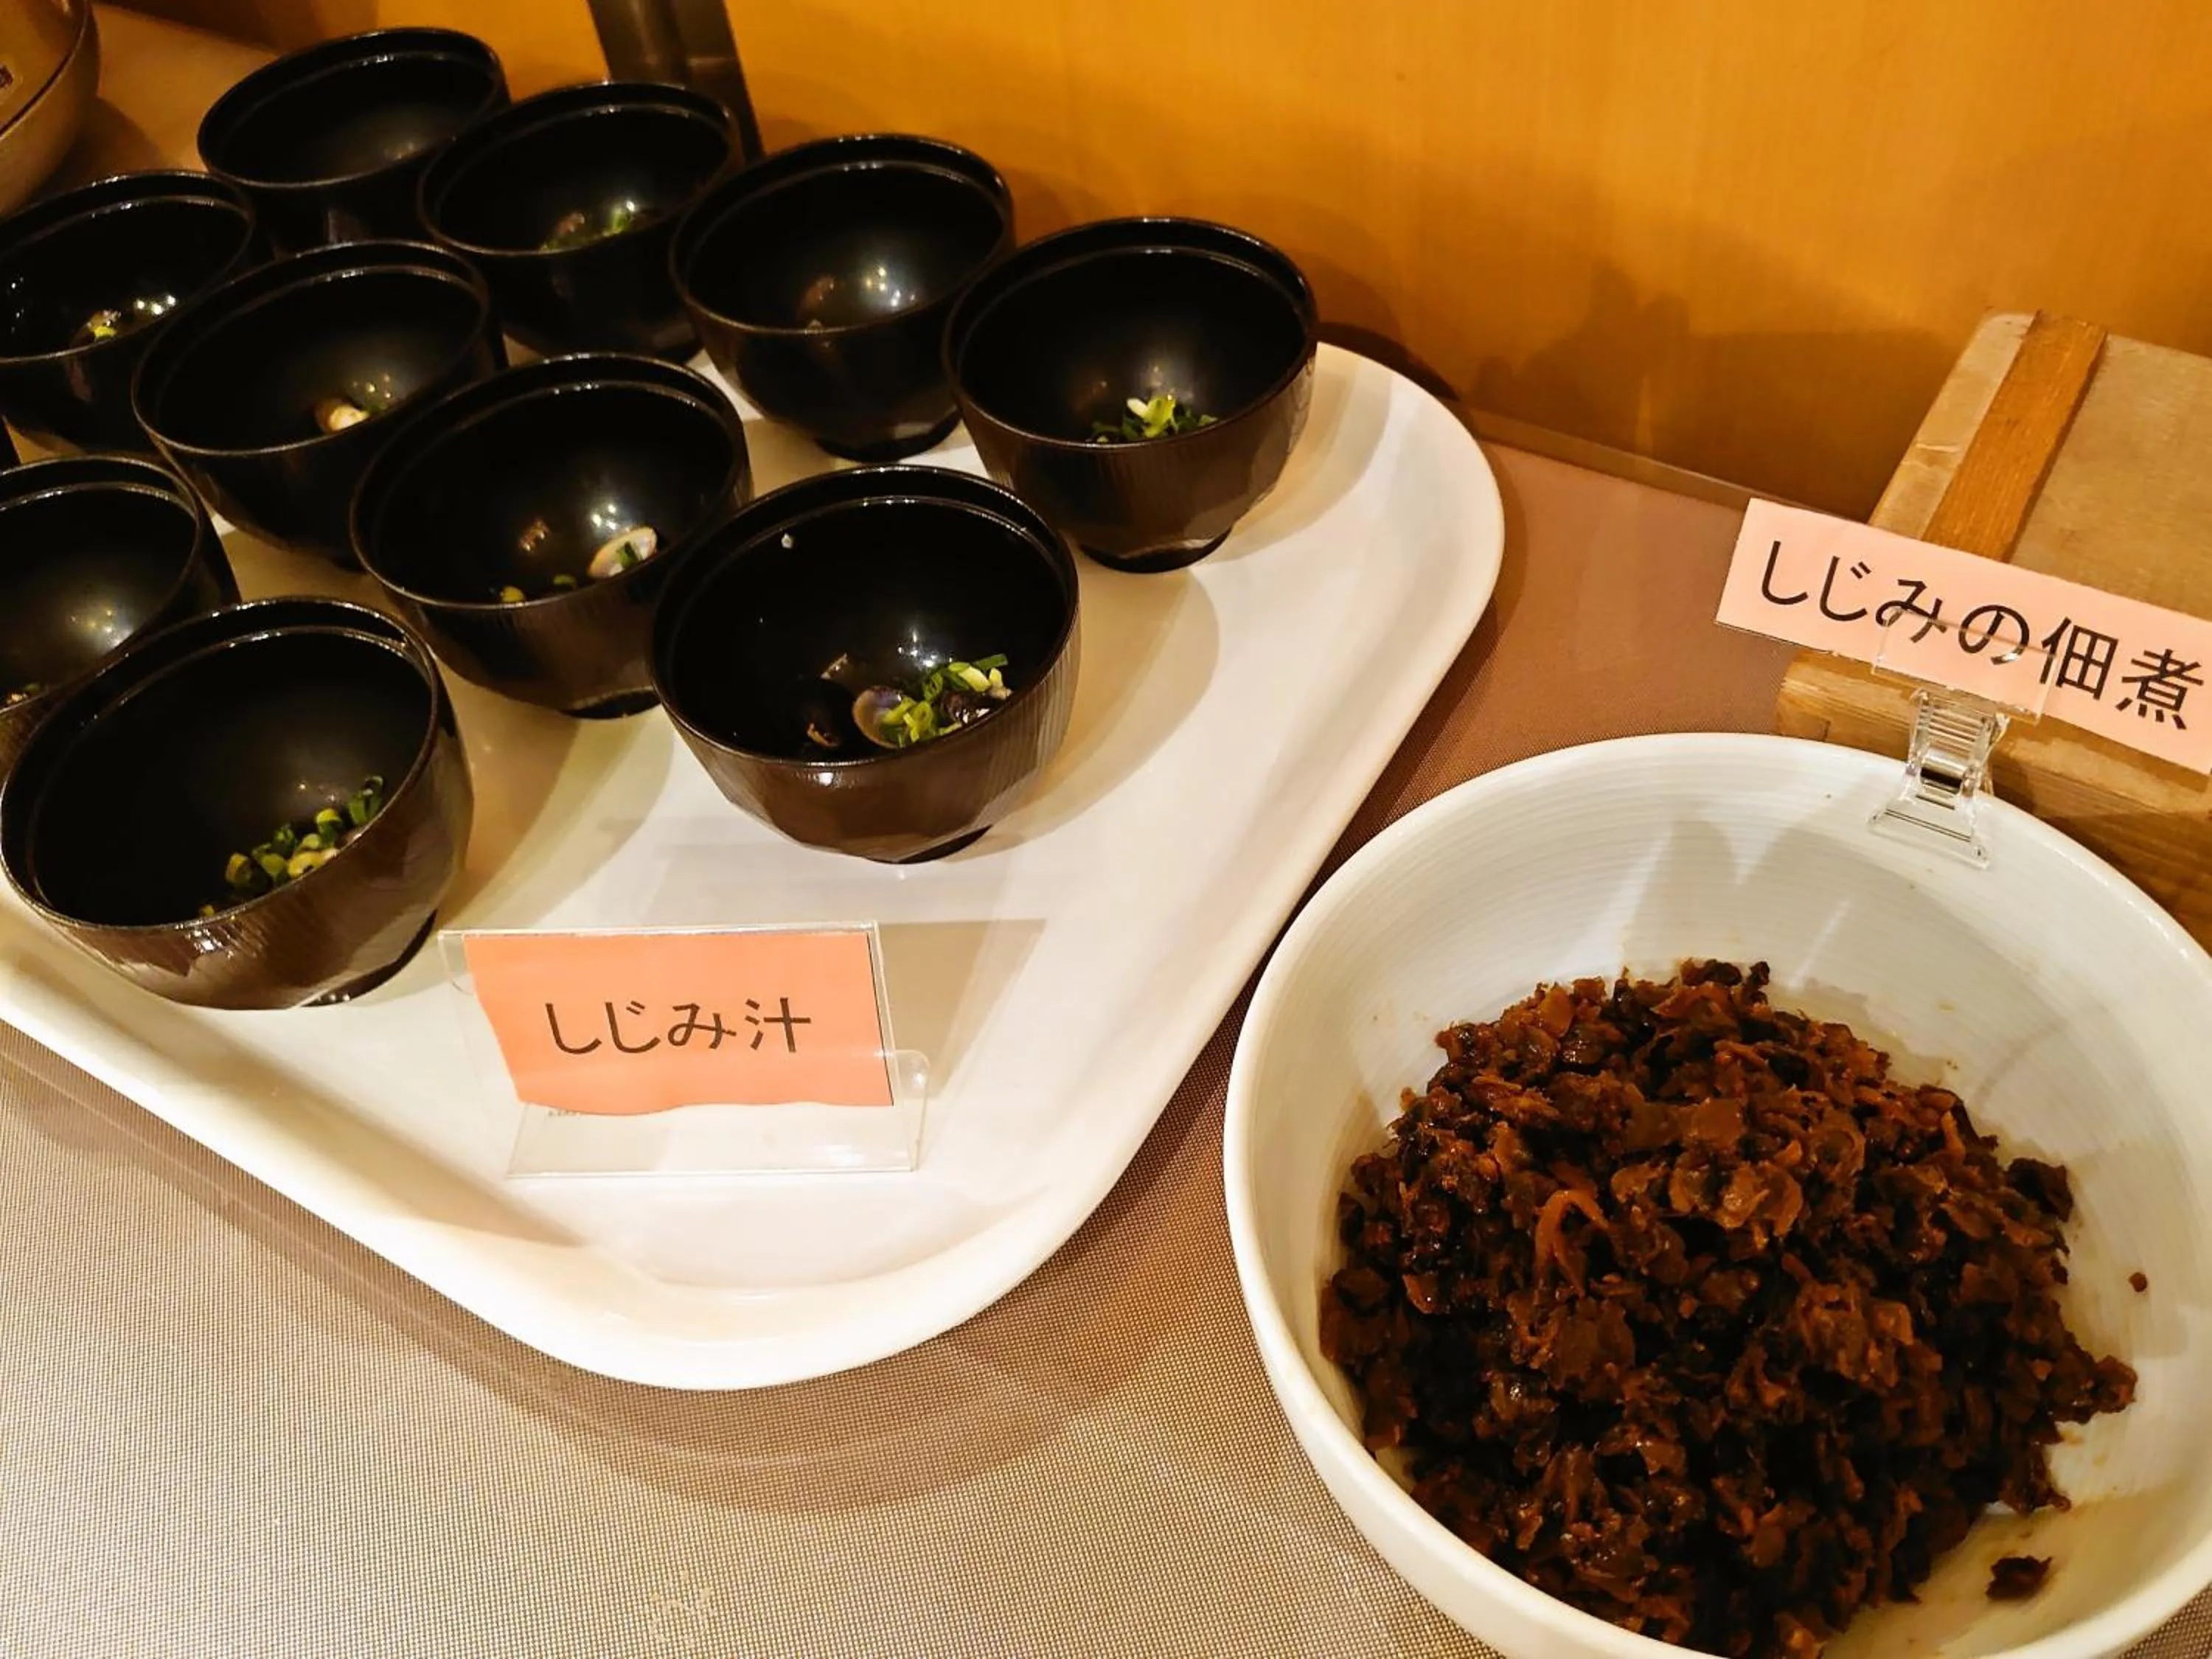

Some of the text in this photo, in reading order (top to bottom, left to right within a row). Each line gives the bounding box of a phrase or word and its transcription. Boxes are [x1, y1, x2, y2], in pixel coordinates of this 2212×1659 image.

[1761, 540, 2205, 731] しじみの佃煮
[545, 997, 811, 1054] しじみ汁
